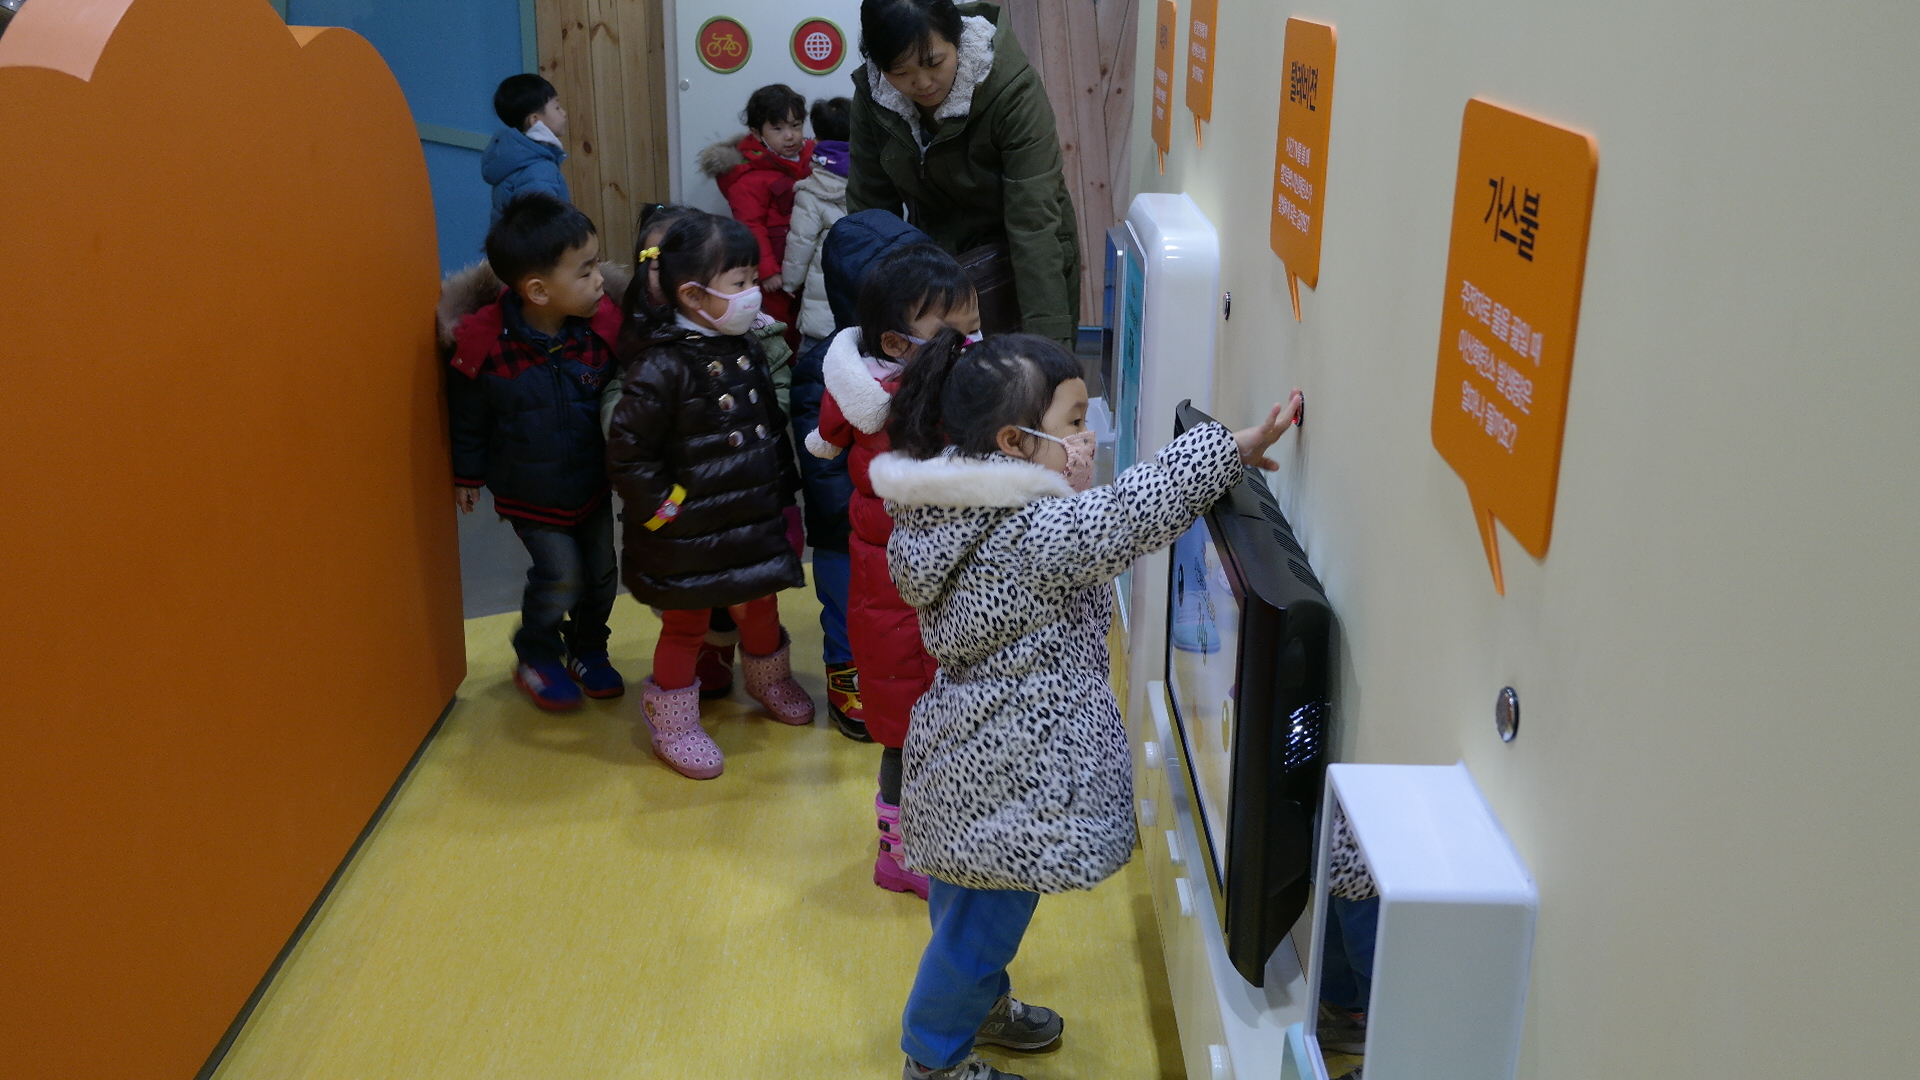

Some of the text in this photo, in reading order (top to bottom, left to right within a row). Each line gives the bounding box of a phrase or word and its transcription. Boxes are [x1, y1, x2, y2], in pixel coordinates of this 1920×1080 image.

[1290, 61, 1319, 112] 텔레비전
[1484, 176, 1540, 262] 가스불
[1461, 280, 1543, 368] 주전자로 물을 끓일 때
[1459, 330, 1533, 416] 이산화탄소 발생량은
[1461, 380, 1485, 427] 얼마나
